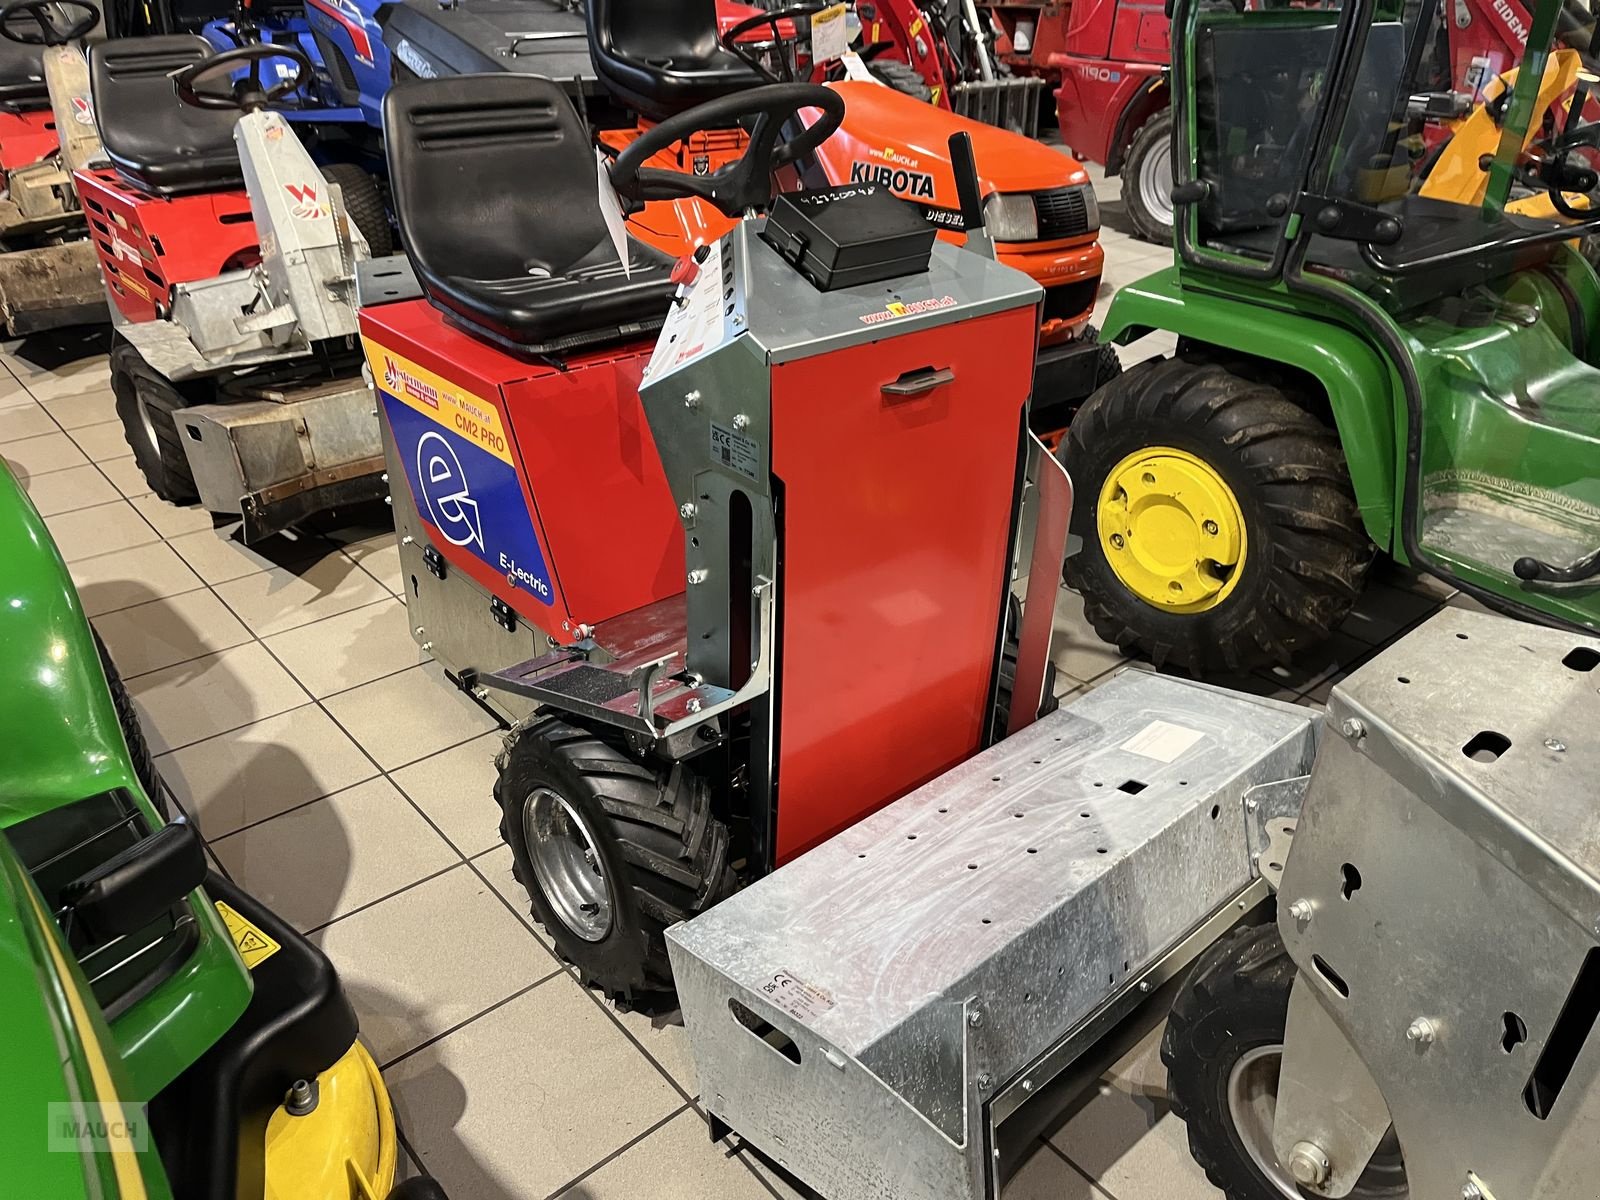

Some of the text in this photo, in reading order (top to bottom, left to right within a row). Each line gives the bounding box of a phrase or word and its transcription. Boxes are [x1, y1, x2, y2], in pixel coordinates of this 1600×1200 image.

[851, 162, 934, 198] KUBOTA
[926, 210, 964, 226] DIESEL
[859, 296, 957, 325] www.MAUCH.at
[455, 413, 504, 452] CM2 PRO
[499, 552, 548, 596] E-Lectric
